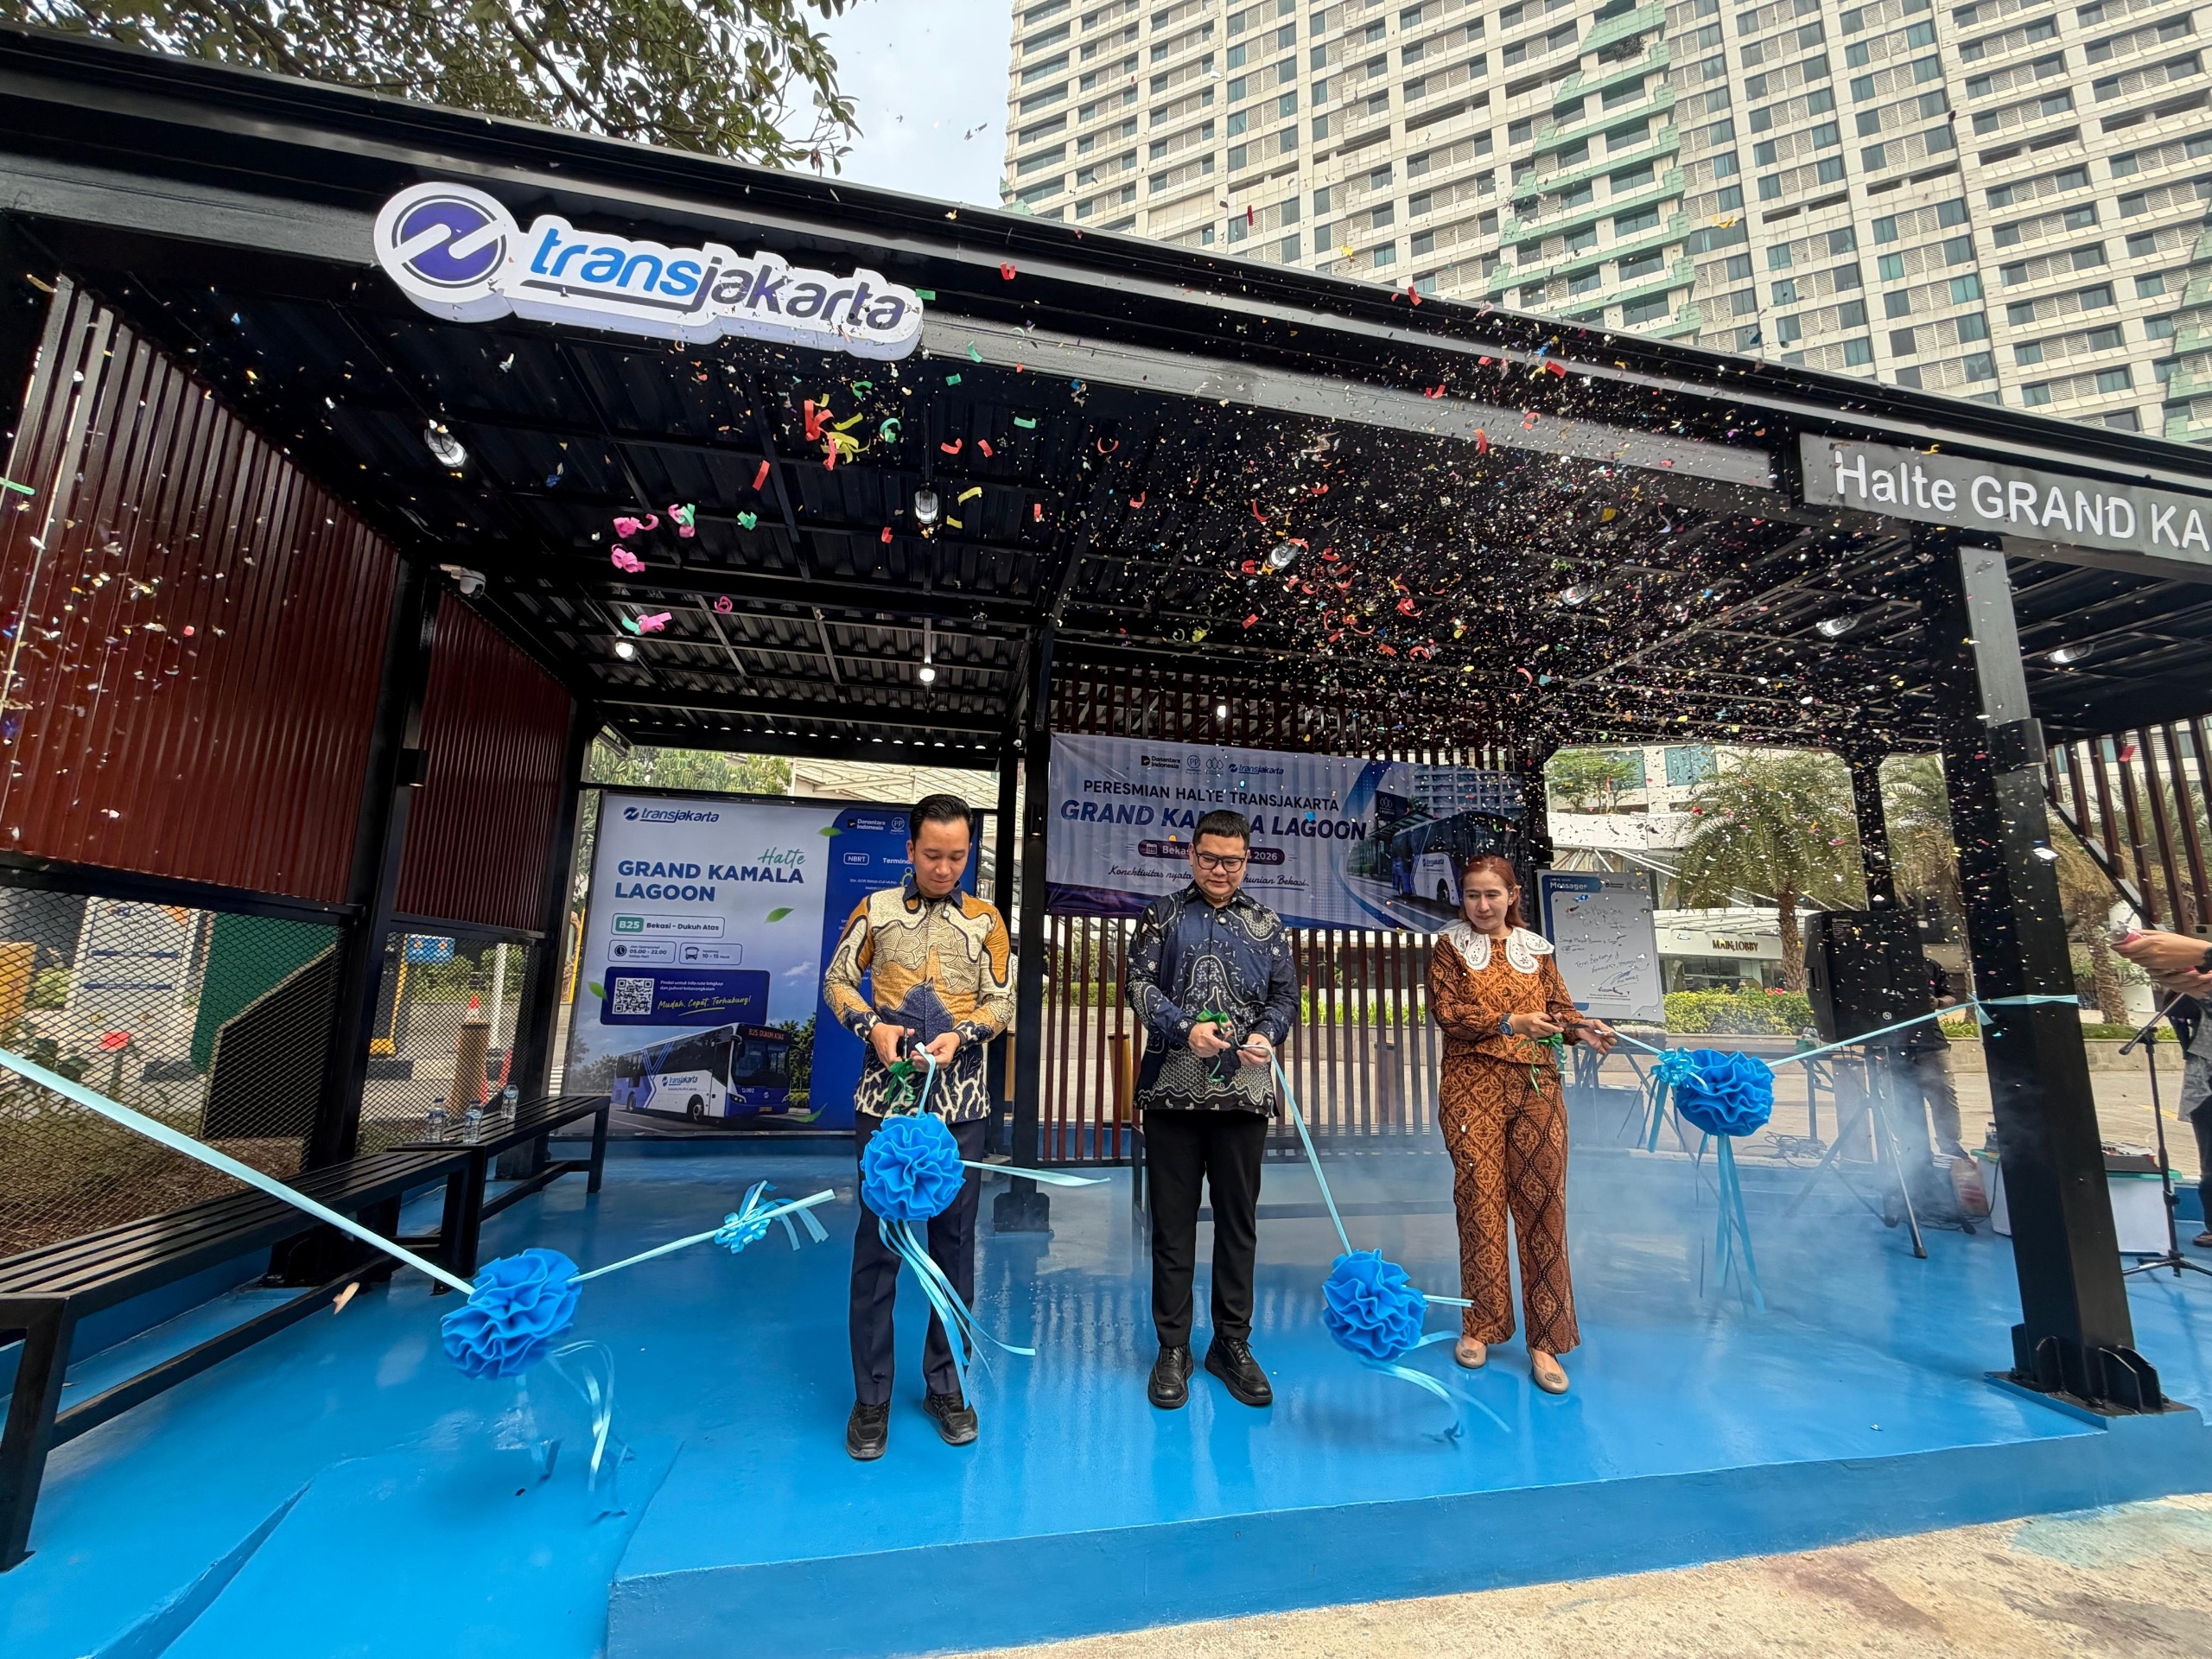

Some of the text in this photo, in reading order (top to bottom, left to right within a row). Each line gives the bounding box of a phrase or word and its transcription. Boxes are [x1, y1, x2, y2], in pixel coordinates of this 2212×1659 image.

[528, 227, 904, 331] transjakarta
[1834, 449, 2209, 552] Halte GRAND KA
[1238, 764, 1284, 775] transjakarta
[1084, 780, 1339, 811] PERESMIAN HALTE TRANSJAKARTA
[641, 807, 720, 823] transjakarta
[1060, 799, 1366, 841] GRAND KAA LAGOON
[758, 848, 805, 868] Halte
[1254, 851, 1278, 861] 2026
[618, 861, 804, 883] GRAND KAMALA
[1108, 865, 1164, 878] Konektivitas
[1166, 872, 1193, 881] nyata
[614, 882, 715, 902] LAGOON
[619, 921, 640, 930] B25
[646, 922, 671, 931] Bekasi
[1713, 939, 1758, 951] MAIN LOBBY
[712, 995, 752, 1006] Terhubung!
[669, 1076, 698, 1085] transjakarta
